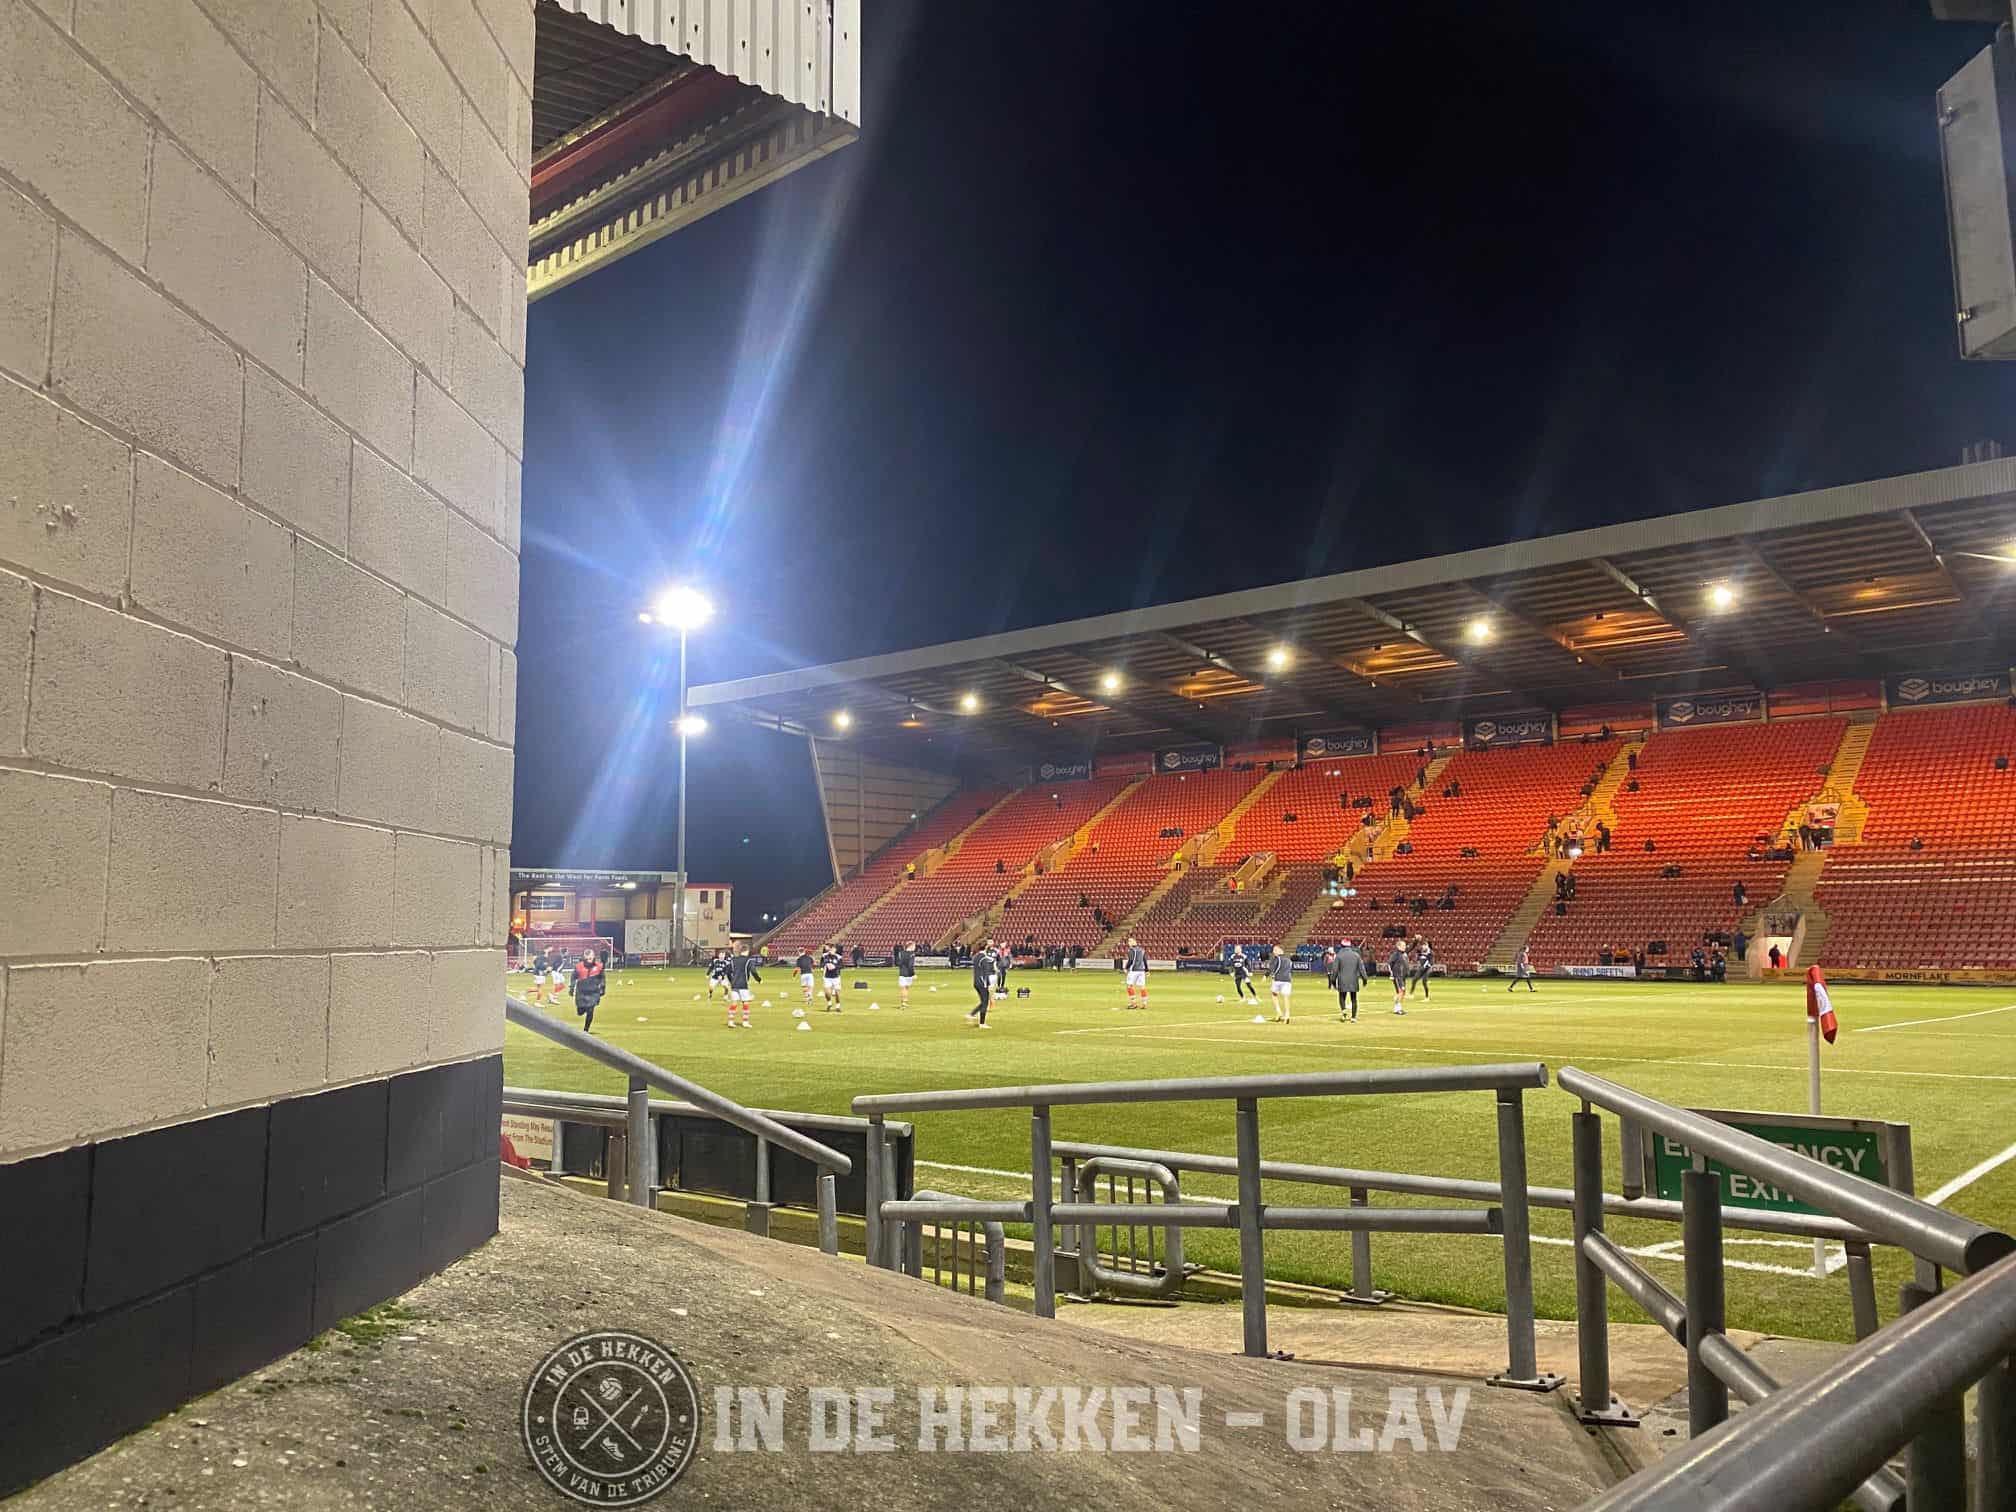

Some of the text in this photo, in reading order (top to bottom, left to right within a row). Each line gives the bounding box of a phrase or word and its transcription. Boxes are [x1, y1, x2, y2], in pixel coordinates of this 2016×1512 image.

[1932, 676, 2000, 692] boughey
[1696, 701, 1753, 716] boughey
[1498, 720, 1546, 735] boughey
[1885, 972, 1951, 981] MORNFLAKE
